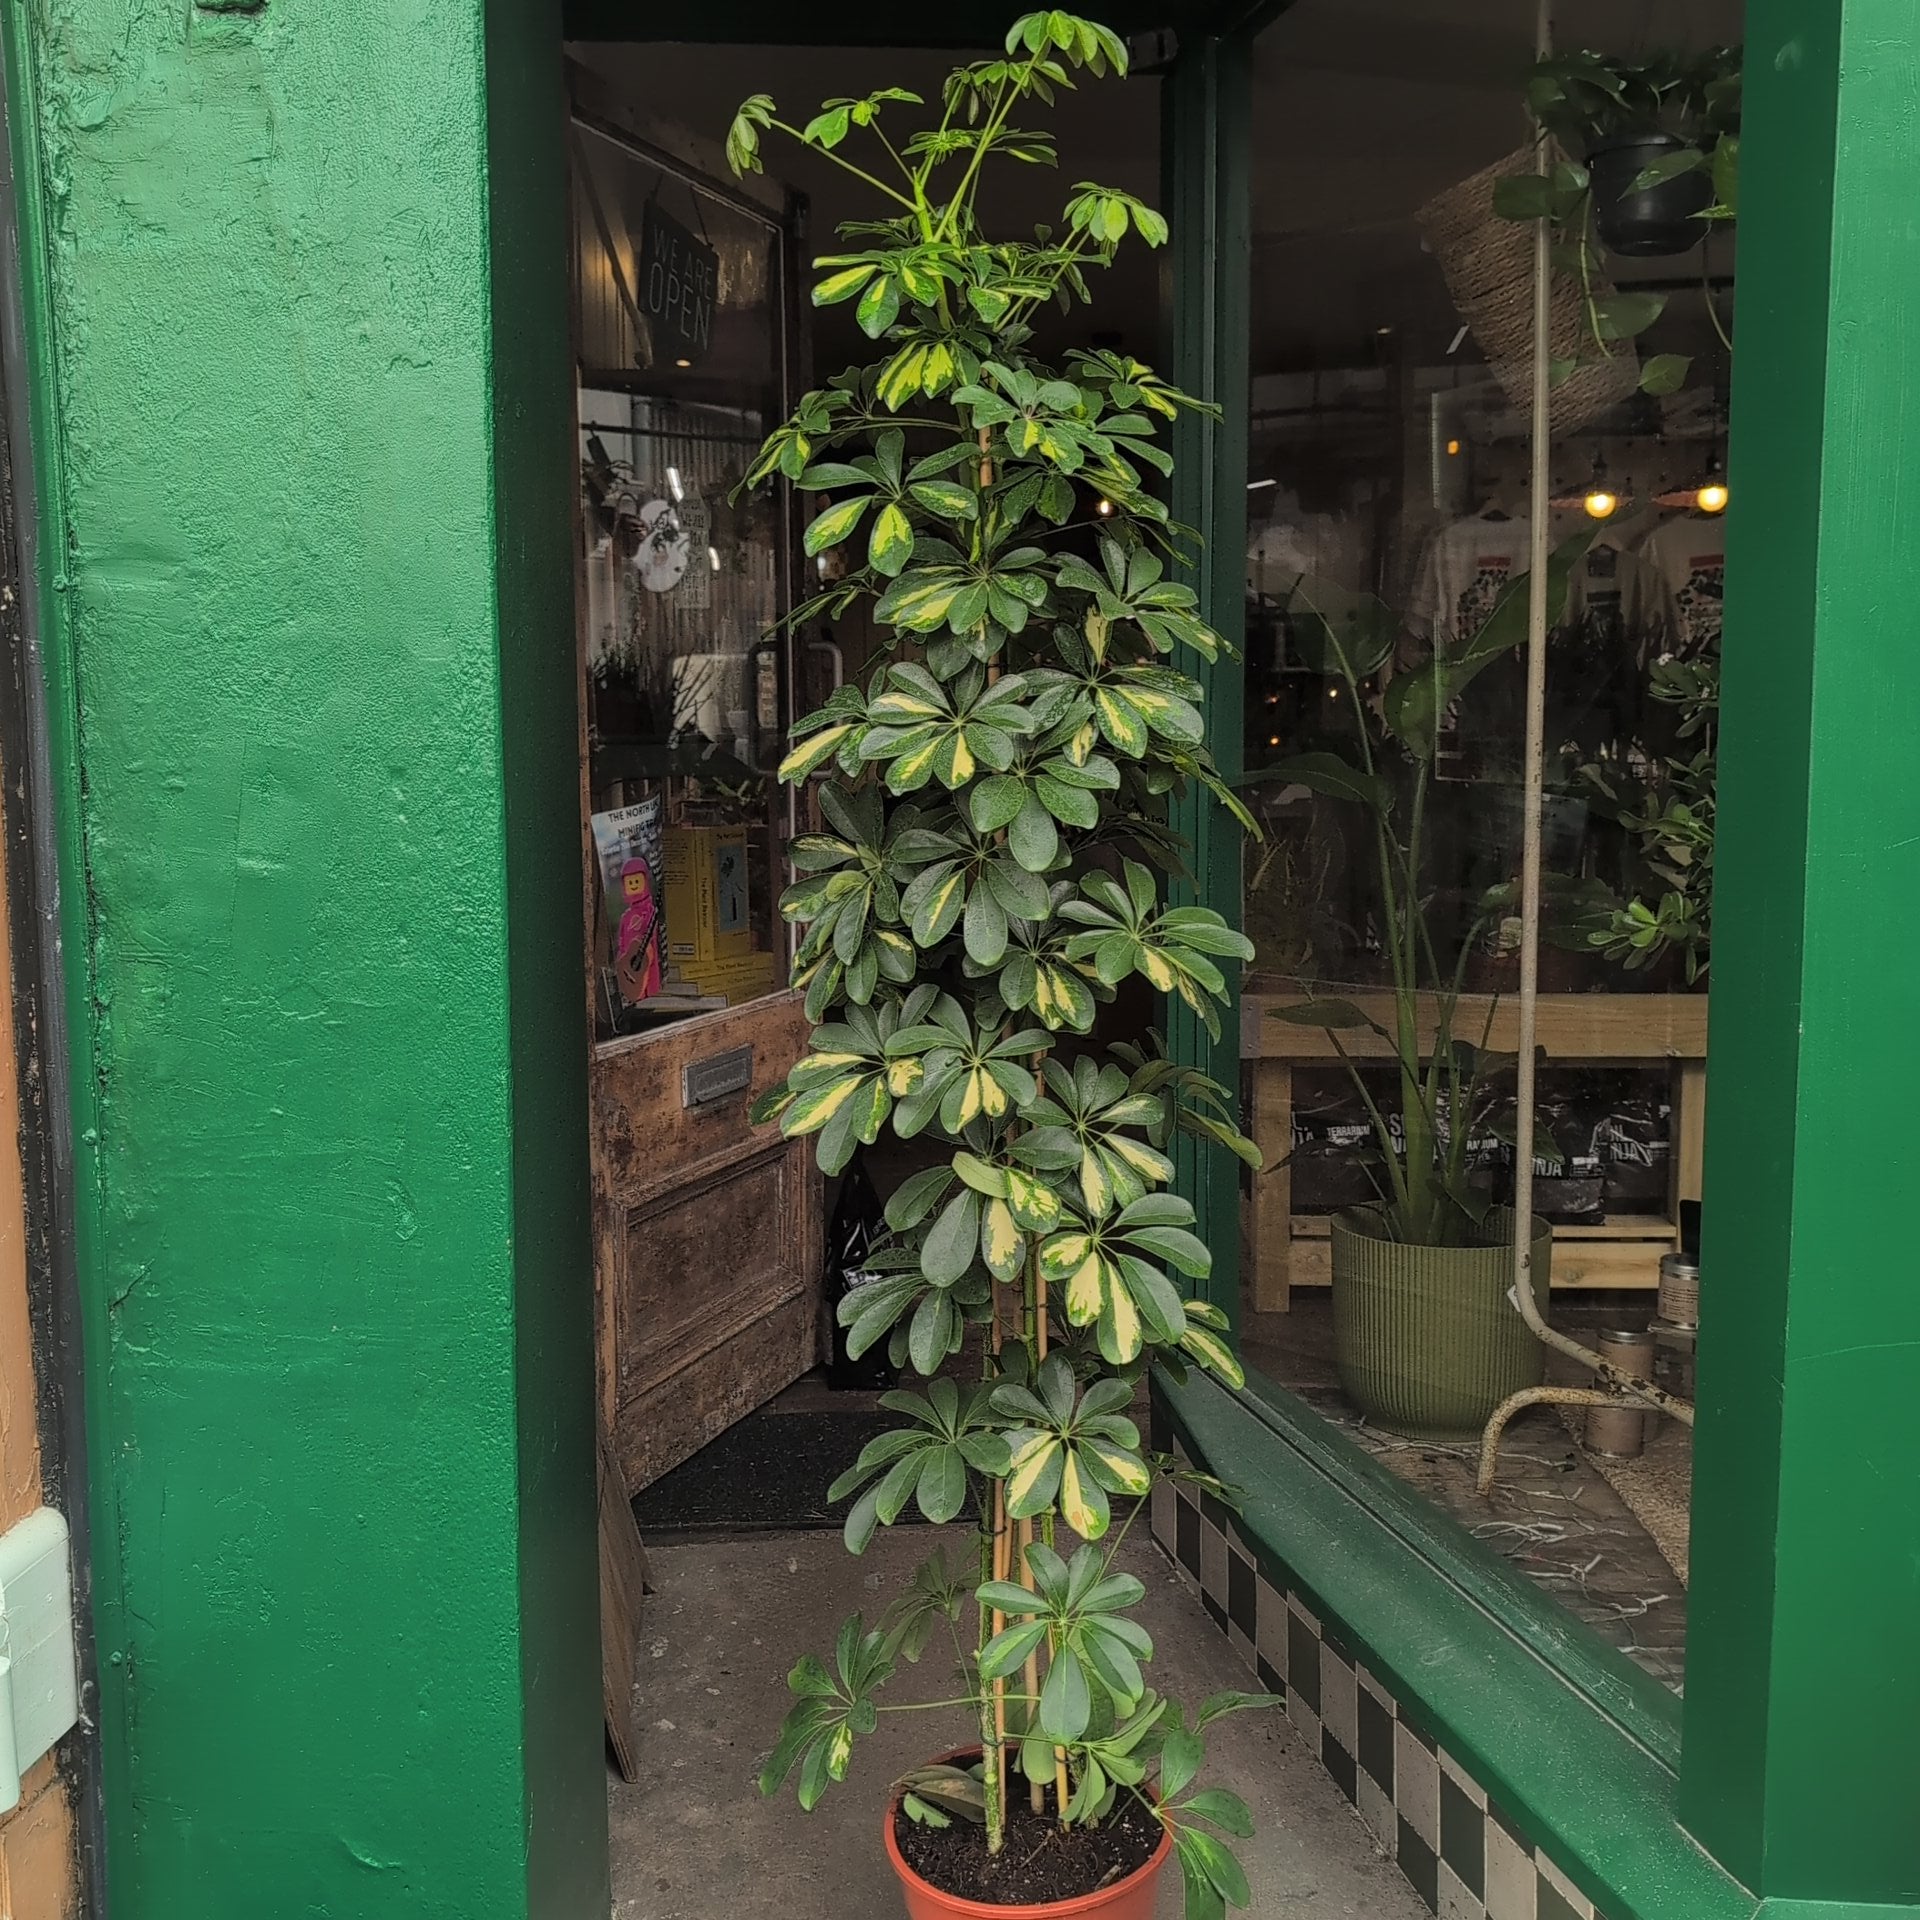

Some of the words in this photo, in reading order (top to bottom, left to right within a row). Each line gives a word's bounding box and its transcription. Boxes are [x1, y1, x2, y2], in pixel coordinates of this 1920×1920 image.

[653, 223, 679, 275] WE
[683, 250, 713, 301] ARE
[649, 260, 711, 352] OPEN
[608, 811, 625, 824] THE
[626, 803, 650, 819] NORTH
